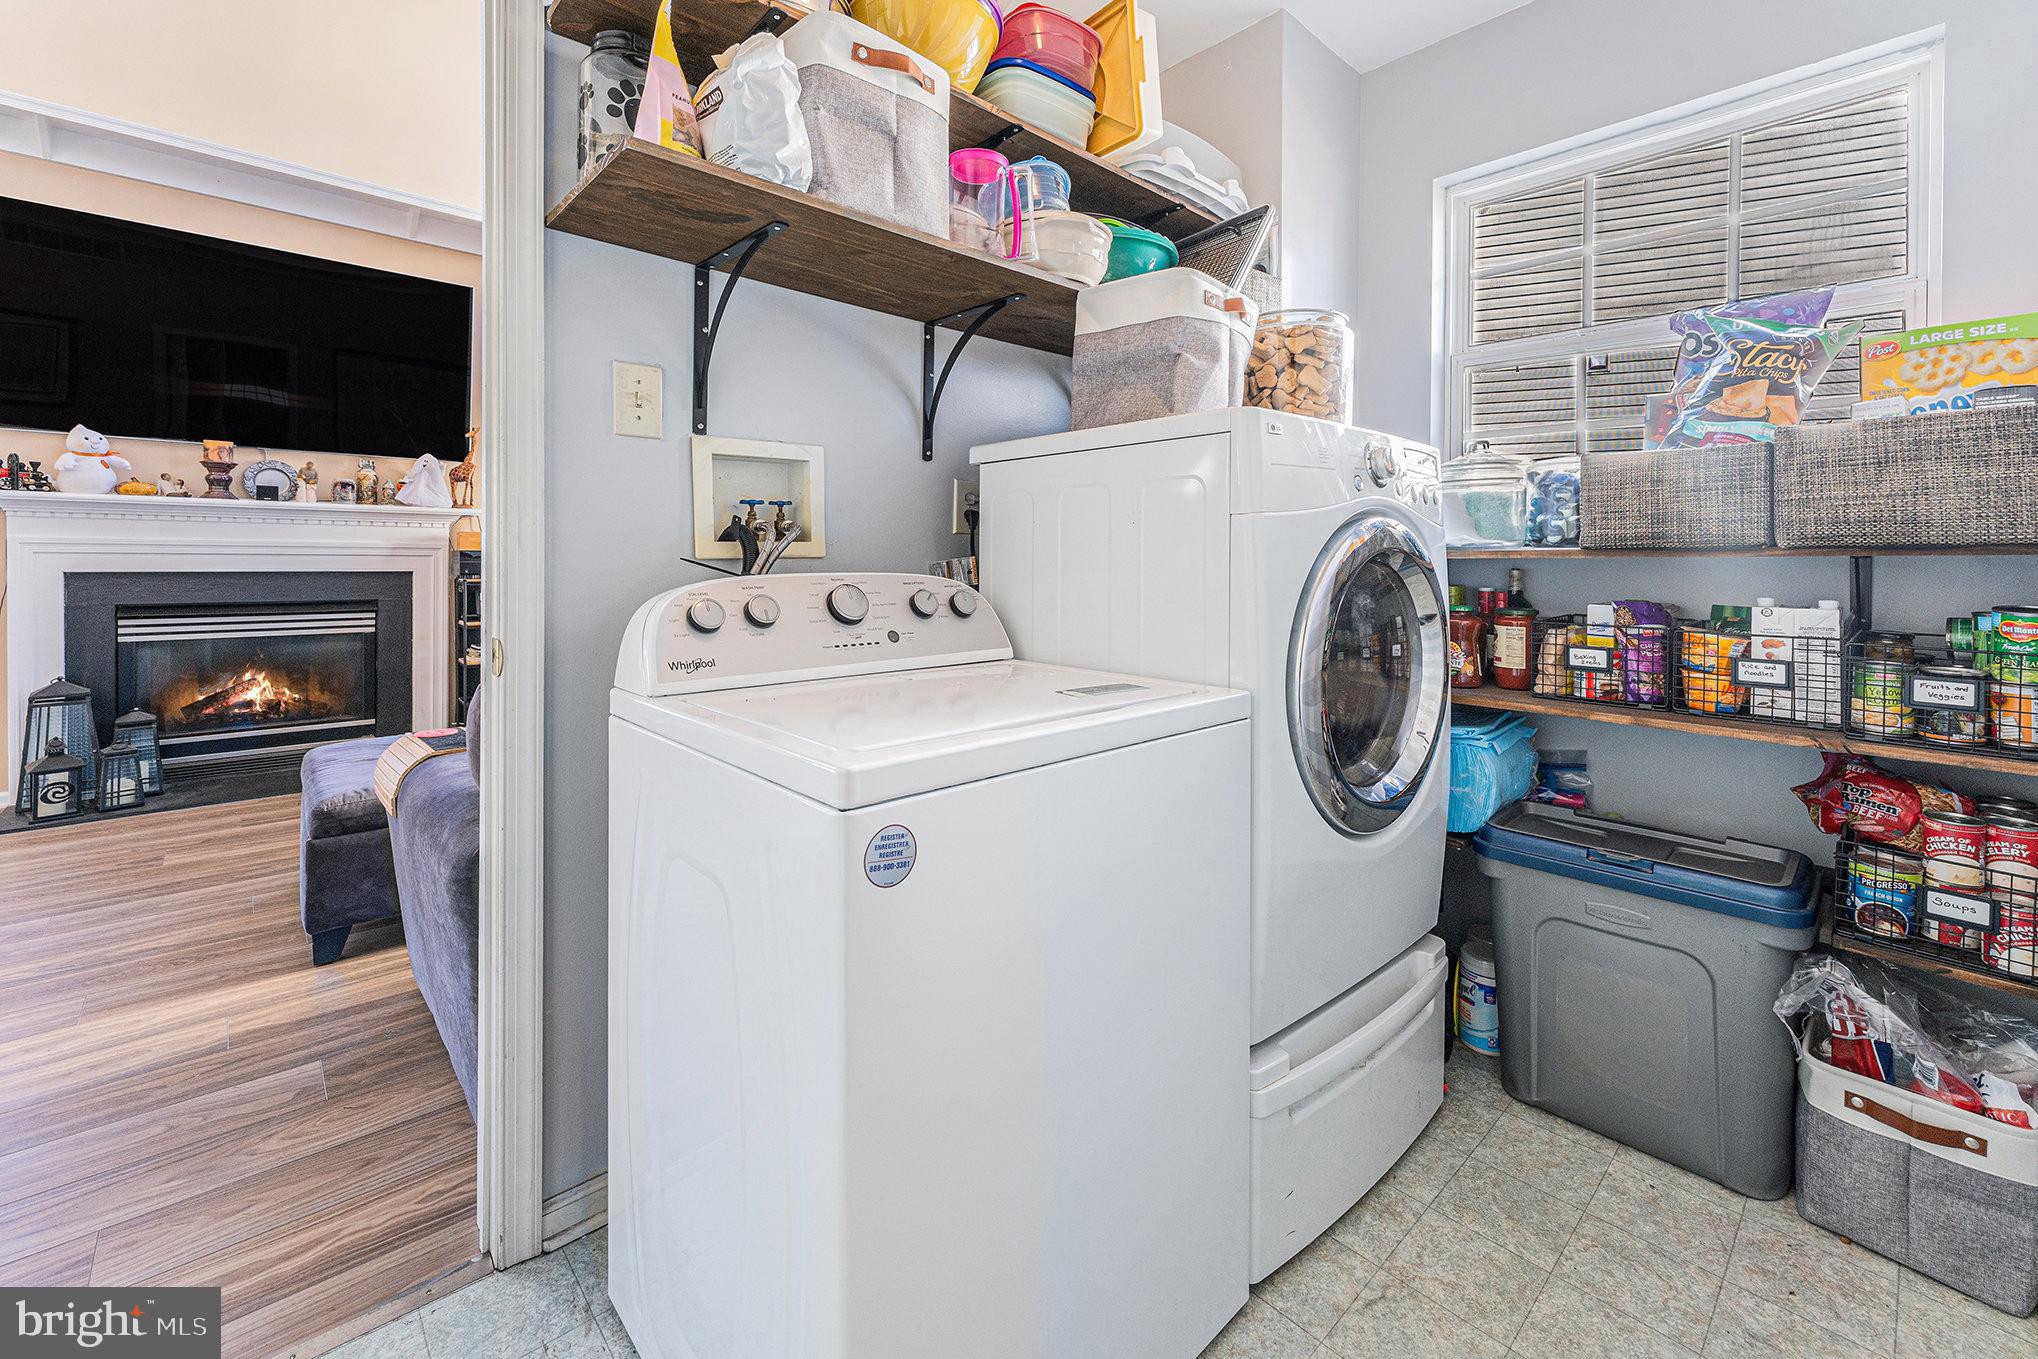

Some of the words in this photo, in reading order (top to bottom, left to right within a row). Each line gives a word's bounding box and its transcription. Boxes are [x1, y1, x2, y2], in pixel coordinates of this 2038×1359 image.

[1910, 328, 1965, 345] LARGE
[1969, 323, 2007, 338] SIZE
[1867, 343, 1895, 359] Post
[1731, 367, 1757, 379] Pita
[1759, 367, 1789, 380] Chips
[2002, 625, 2013, 633] Del
[667, 658, 716, 674] Whirlpool
[1994, 655, 2018, 667] GEEN
[1920, 683, 1951, 691] Fruits
[1927, 692, 1966, 701] Veggies
[1840, 781, 1873, 799] Top
[1842, 790, 1902, 817] Ramen
[1852, 804, 1885, 820] BEEF
[880, 833, 905, 842] REGISTER
[1926, 835, 1955, 843] CREAM
[1957, 837, 1972, 845] OF
[1925, 841, 1976, 854] CHICKEN
[1932, 896, 1977, 914] Soups
